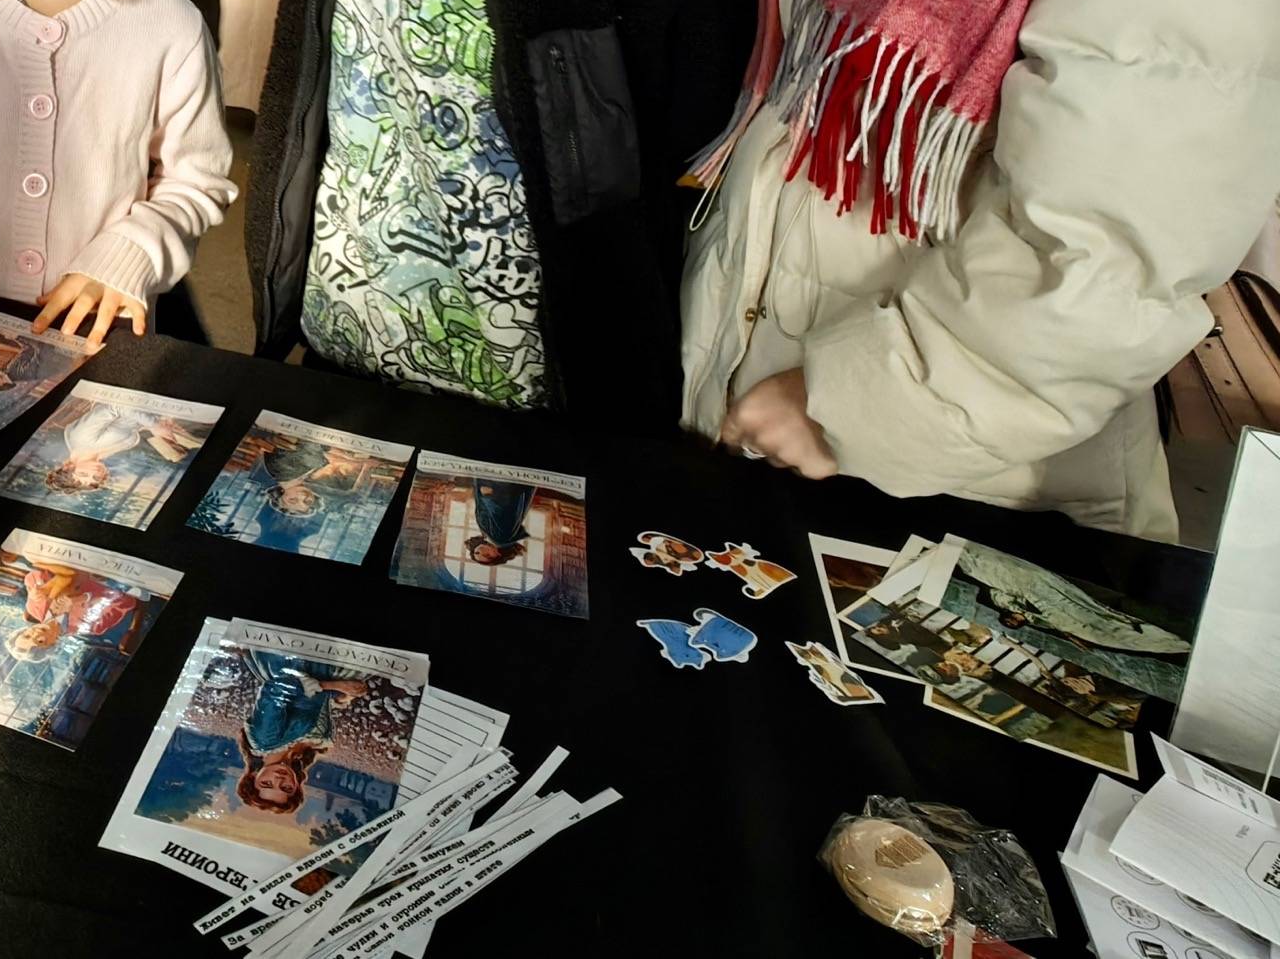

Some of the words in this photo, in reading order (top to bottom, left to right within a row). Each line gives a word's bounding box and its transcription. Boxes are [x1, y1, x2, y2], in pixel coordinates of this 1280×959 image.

[200, 907, 235, 931] Живет
[241, 896, 255, 906] на
[260, 873, 292, 894] вилле
[349, 810, 405, 843] обезьянкой
[475, 860, 503, 880] штате
[328, 908, 374, 936] матерью
[378, 892, 404, 907] трех
[407, 864, 453, 892] крылатых
[457, 841, 495, 864] существ
[228, 935, 245, 945] За
[347, 930, 378, 951] чулки
